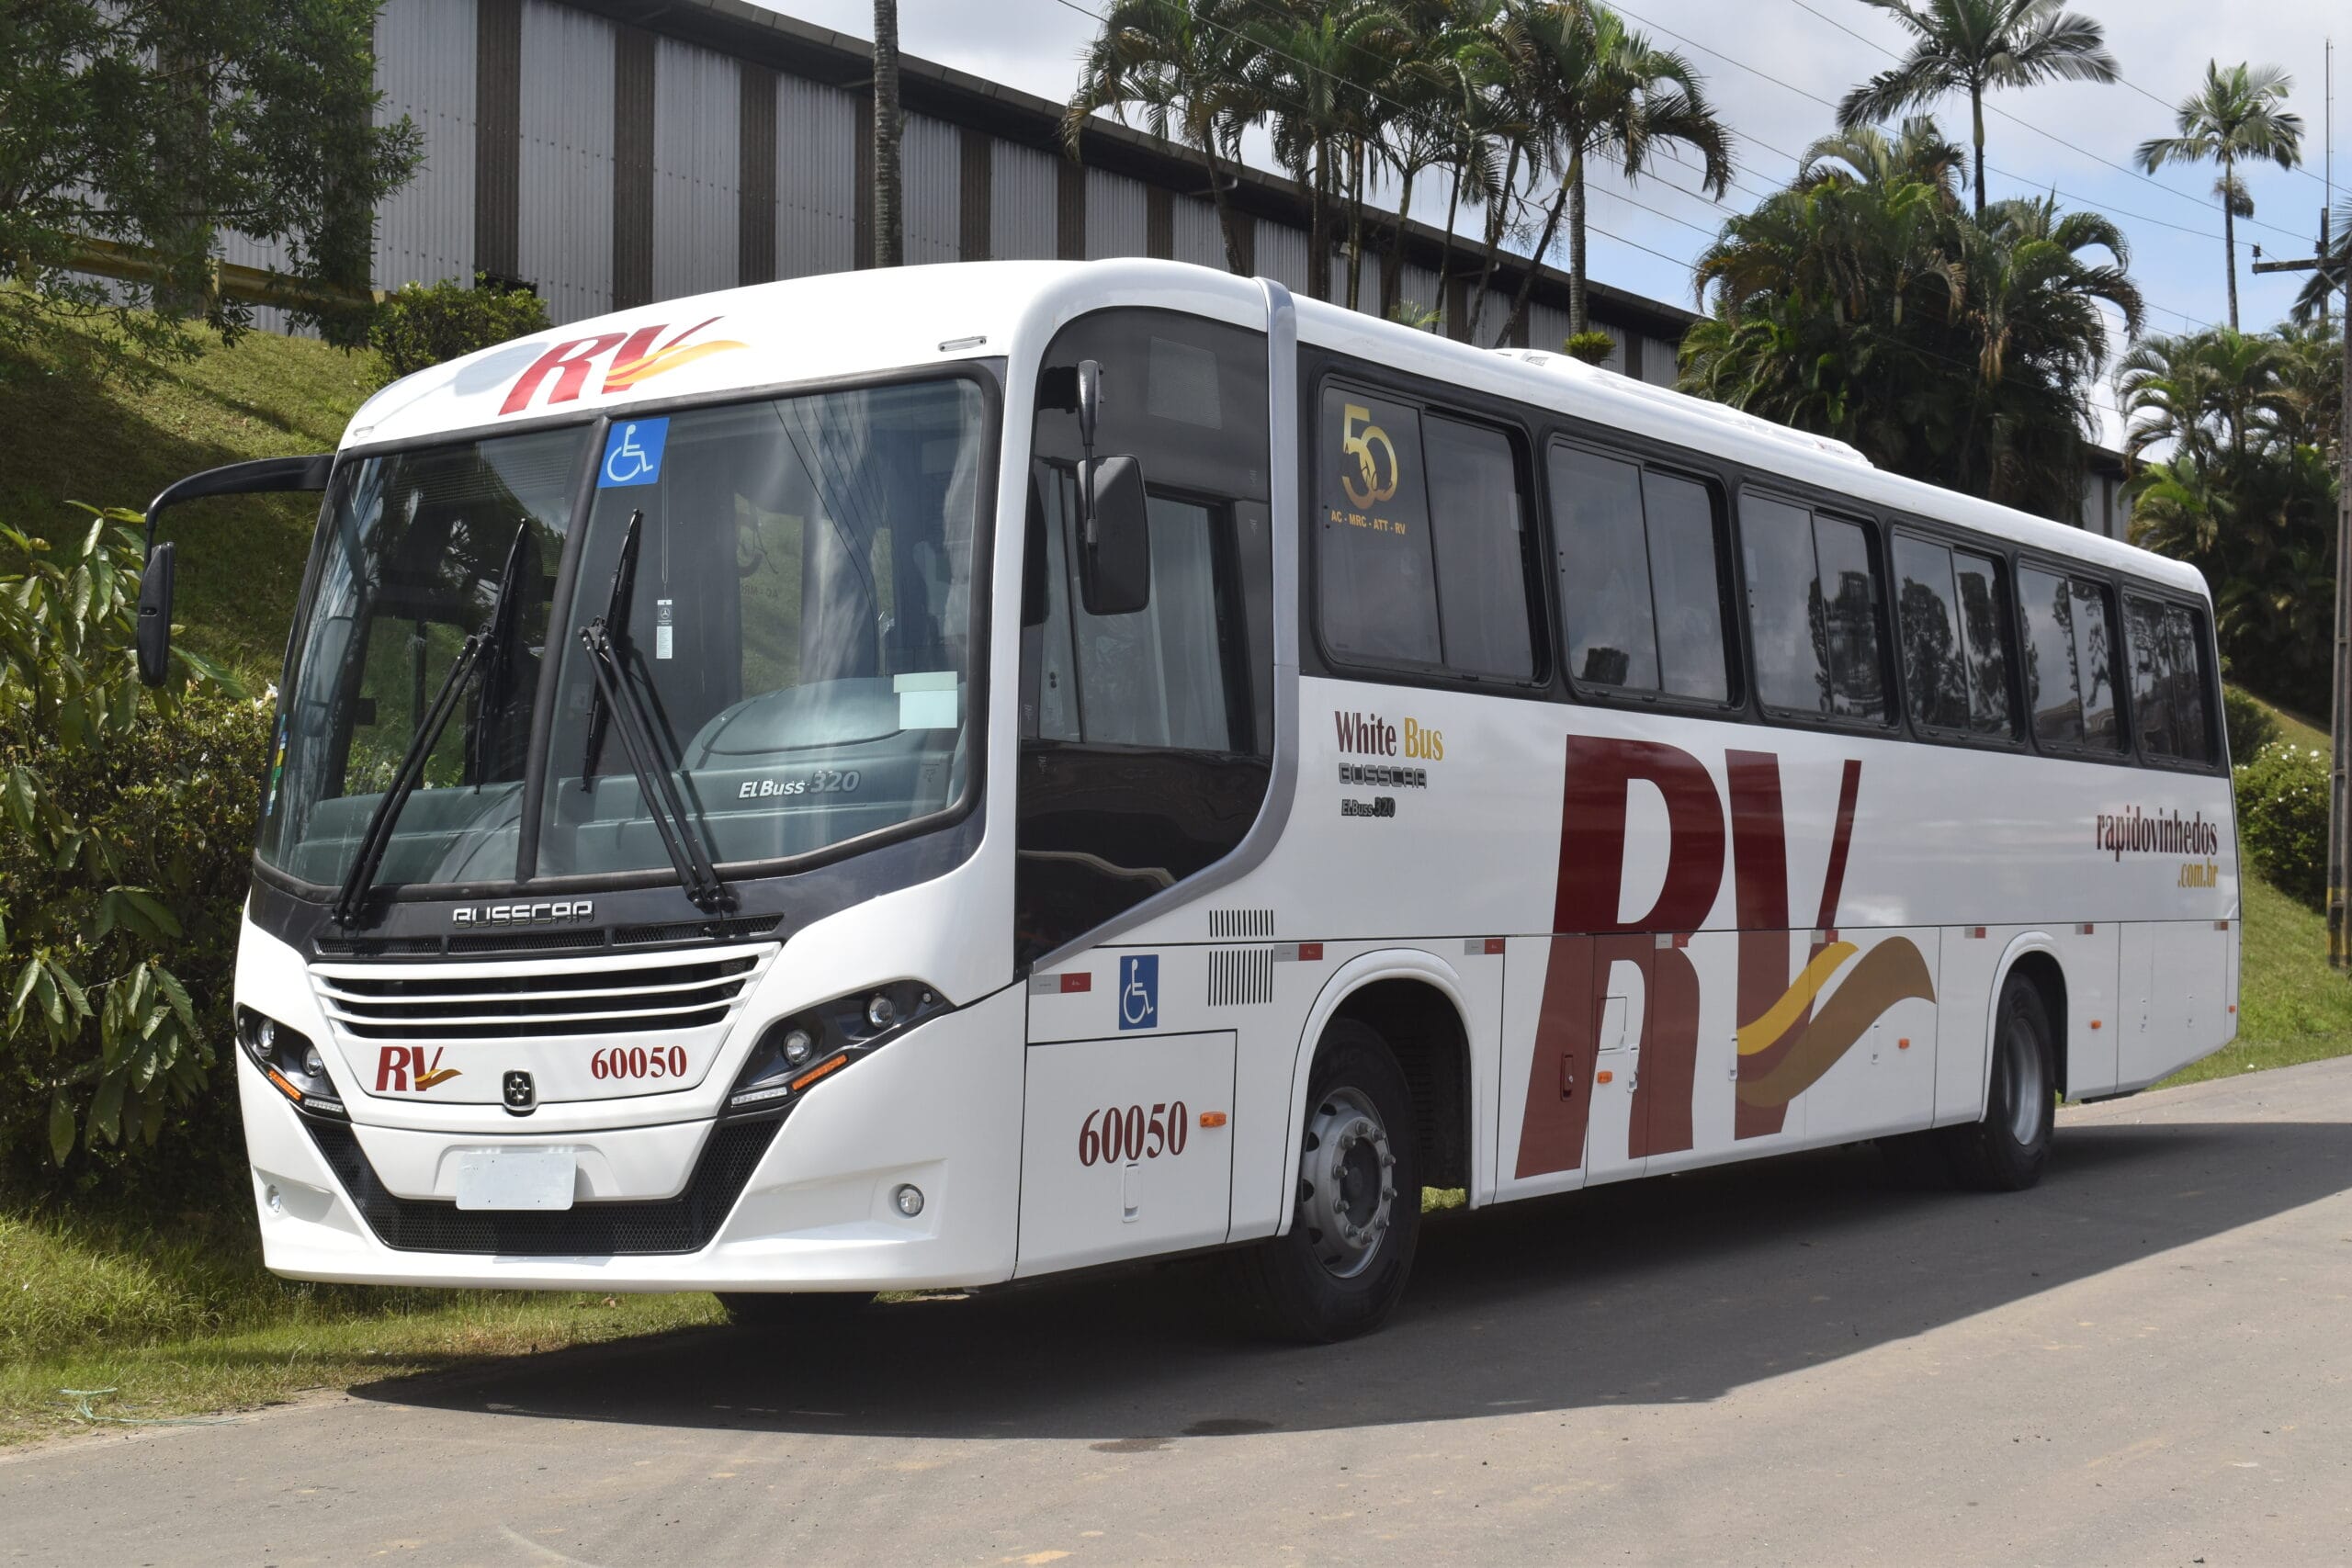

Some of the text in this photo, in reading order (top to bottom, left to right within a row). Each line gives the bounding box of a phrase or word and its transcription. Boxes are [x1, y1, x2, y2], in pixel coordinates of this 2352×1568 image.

[498, 316, 725, 415] RV
[1342, 403, 1397, 510] 50
[1331, 510, 1342, 523] AC
[1349, 513, 1367, 527] MRC
[1374, 518, 1388, 532] ATT
[1395, 522, 1406, 535] RV
[1334, 711, 1443, 761] White Bus
[809, 770, 861, 794] 320
[1339, 762, 1427, 789] BUSSCAR
[2097, 805, 2217, 862] rapidovinhedos
[2177, 857, 2218, 888] .com.br
[453, 900, 594, 929] BUSSCAR
[1514, 734, 1862, 1179] RV
[375, 1046, 445, 1091] RV
[591, 1045, 687, 1079] 60050
[1079, 1100, 1187, 1167] 60050
